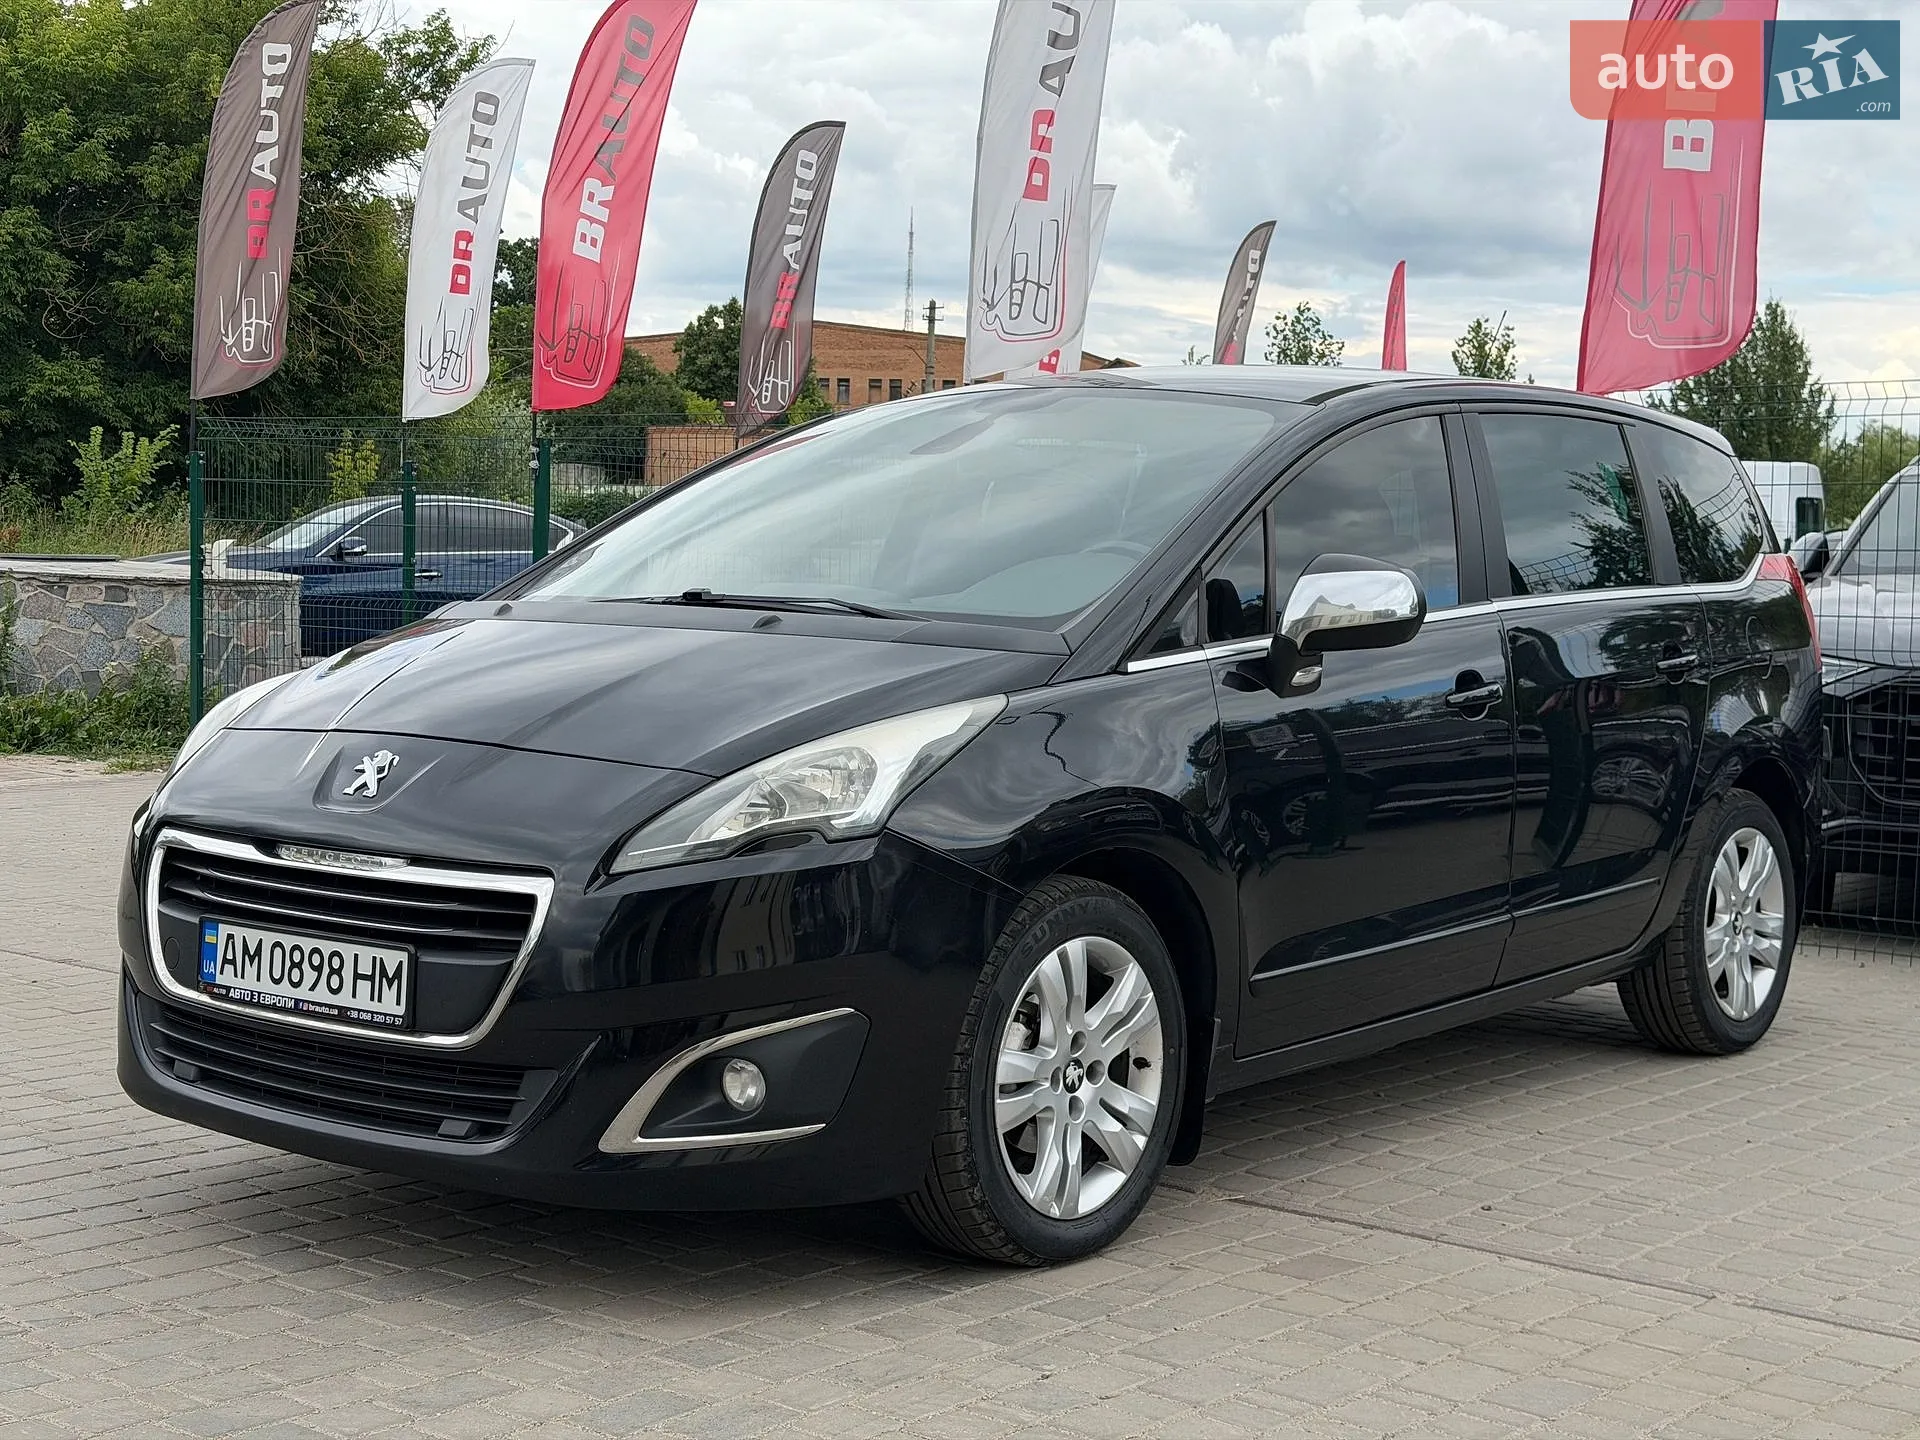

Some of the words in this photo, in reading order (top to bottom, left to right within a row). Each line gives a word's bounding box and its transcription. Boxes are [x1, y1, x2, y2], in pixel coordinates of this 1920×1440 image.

[572, 13, 656, 264] BRAUTO
[770, 149, 818, 329] BRAUTO
[203, 960, 215, 974] UA
[219, 932, 263, 983] AM
[268, 940, 345, 995] 0898
[351, 953, 404, 1006] HM
